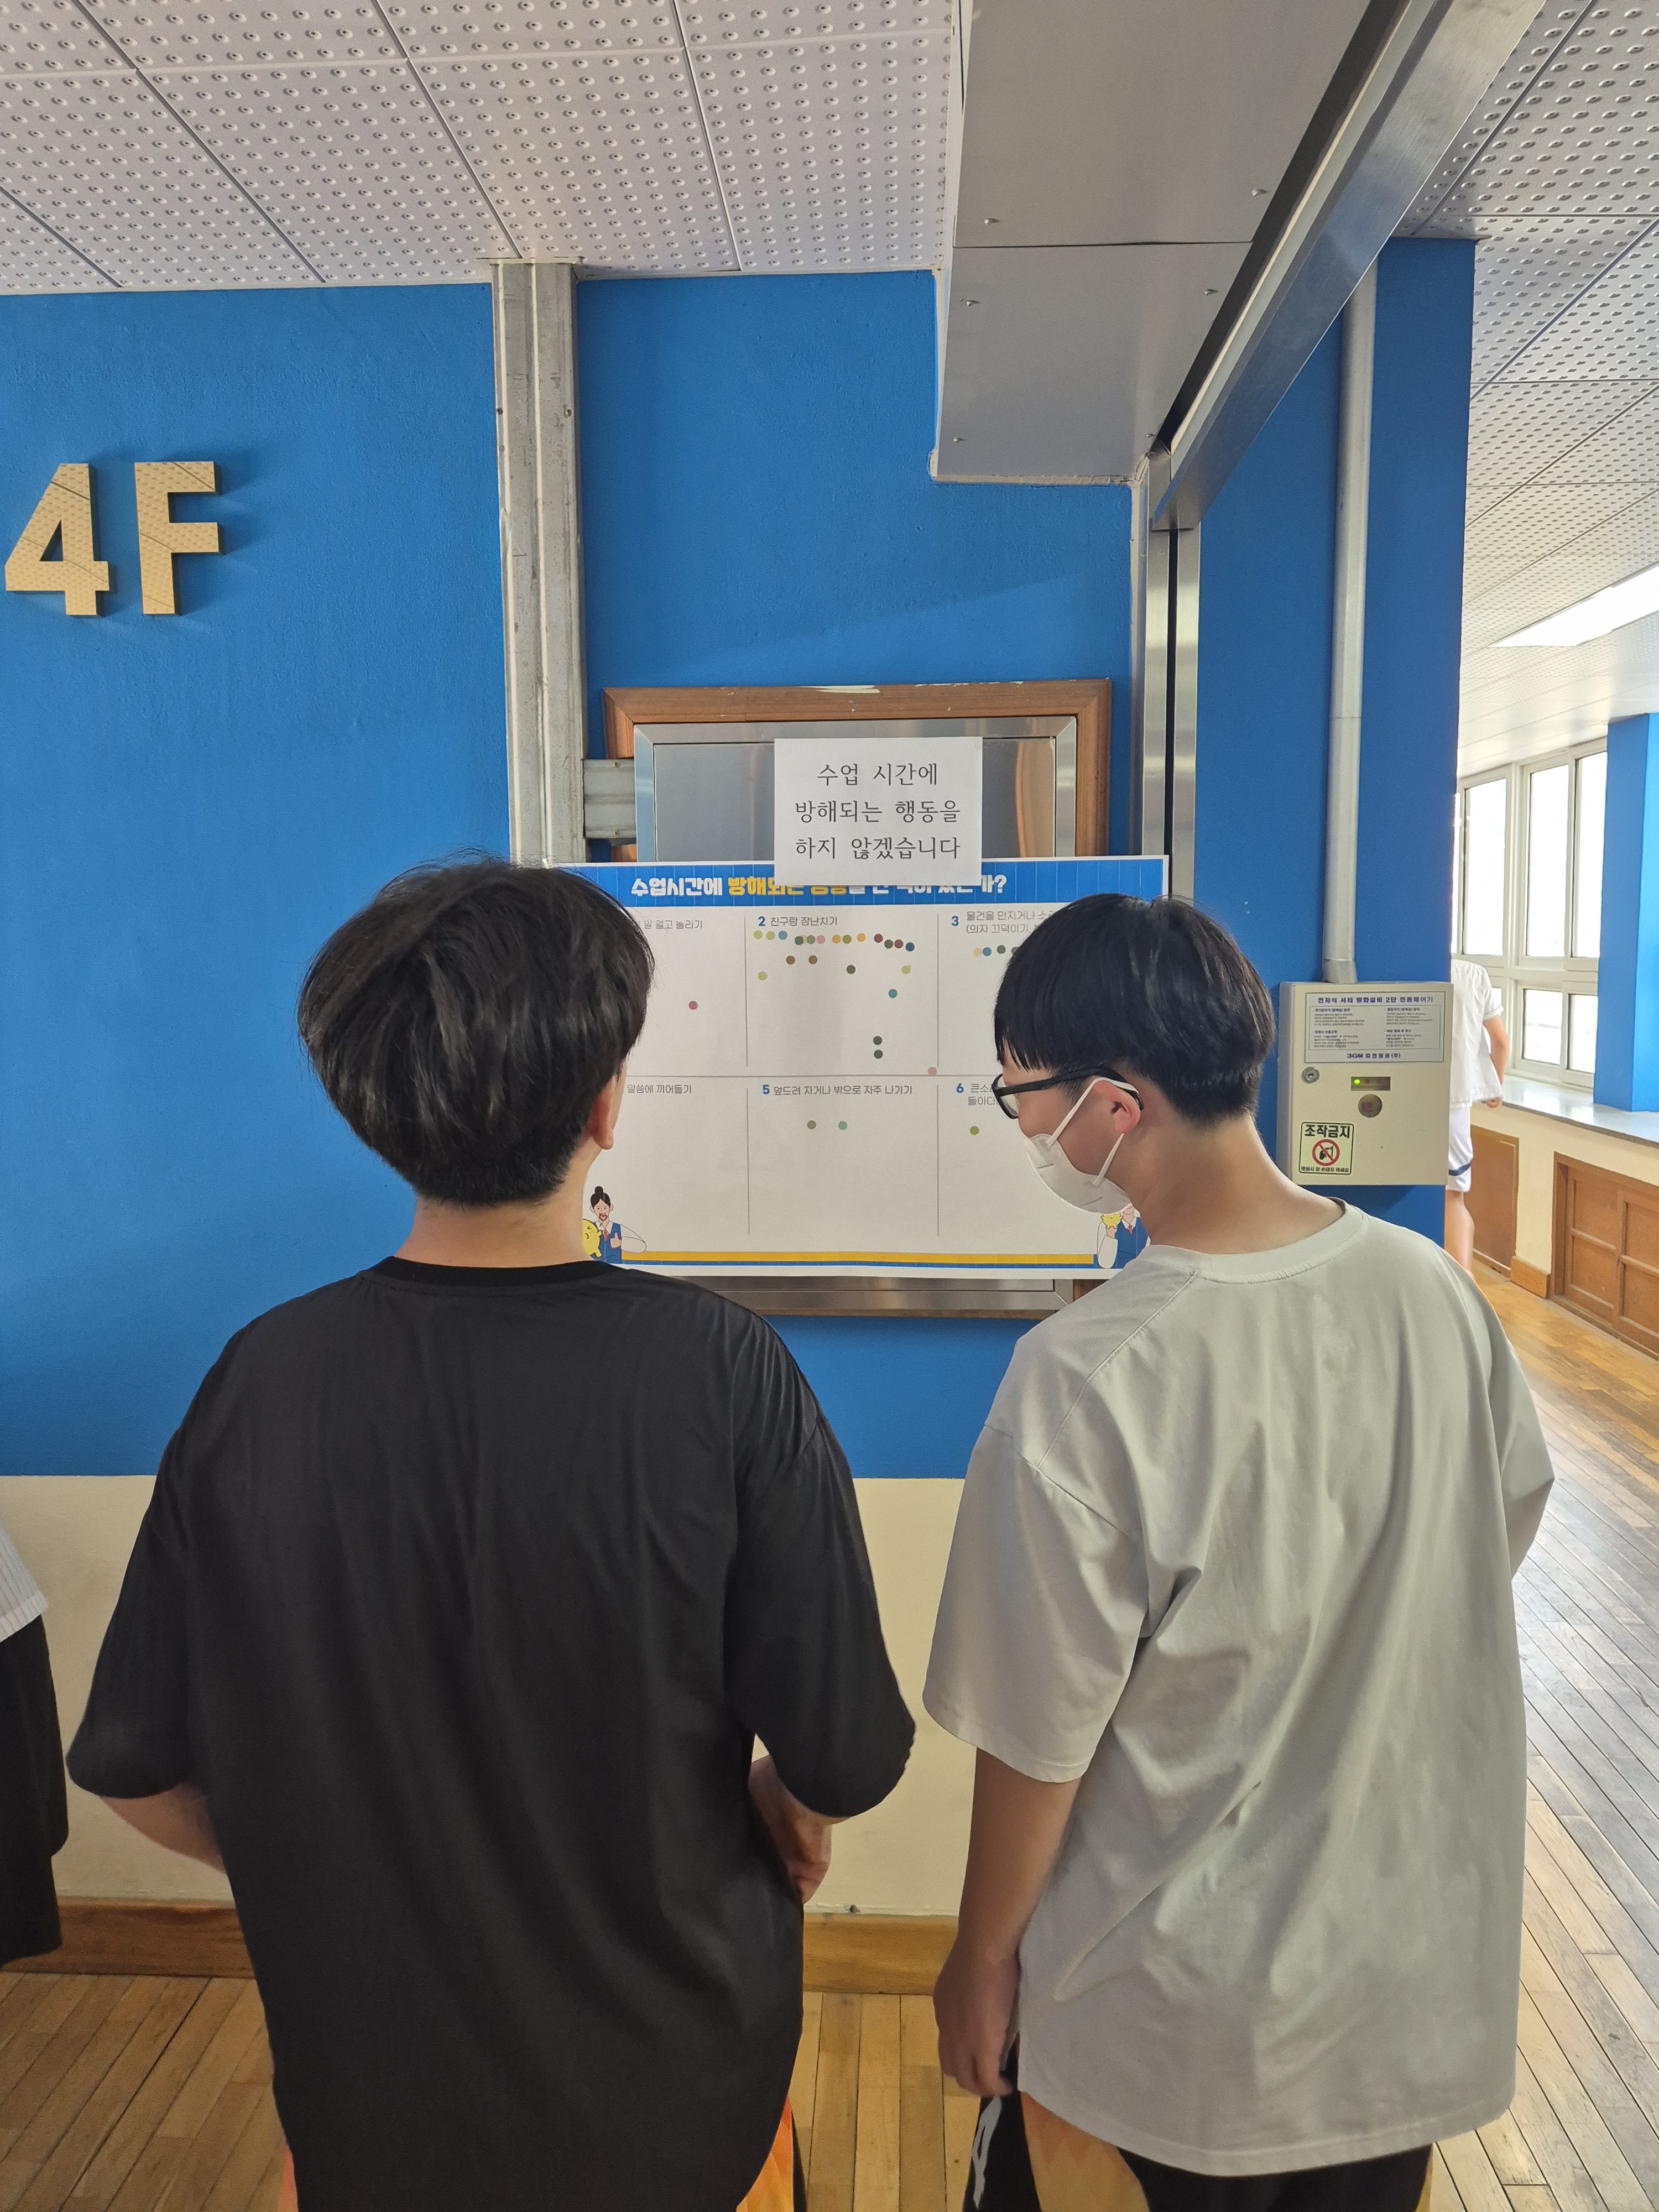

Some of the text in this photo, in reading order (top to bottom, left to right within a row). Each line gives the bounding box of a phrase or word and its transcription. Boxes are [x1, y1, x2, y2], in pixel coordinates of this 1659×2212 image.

[4, 461, 220, 615] 4F
[817, 763, 937, 786] 수업 시간에
[795, 800, 961, 823] 방해되는 행동을
[795, 837, 961, 859] 하지 않겠습니다
[631, 877, 723, 896] 수업시간에
[644, 920, 653, 929] 말
[655, 920, 673, 929] 걸고
[676, 920, 702, 929] 놀리기
[758, 916, 837, 927] 2 친구랑 장난치기
[951, 915, 959, 927] 3
[966, 911, 994, 921] 물건을
[997, 911, 1035, 920] 만지거나
[966, 924, 988, 934] (의자
[627, 1084, 692, 1094] 말씀에 끼어들기
[762, 1084, 912, 1095] 5 엎드려 자거나 밖으로 자주 나가기
[956, 1083, 964, 1093] 6
[968, 1096, 999, 1105] 돌아다
[1304, 1124, 1350, 1139] 조작금지
